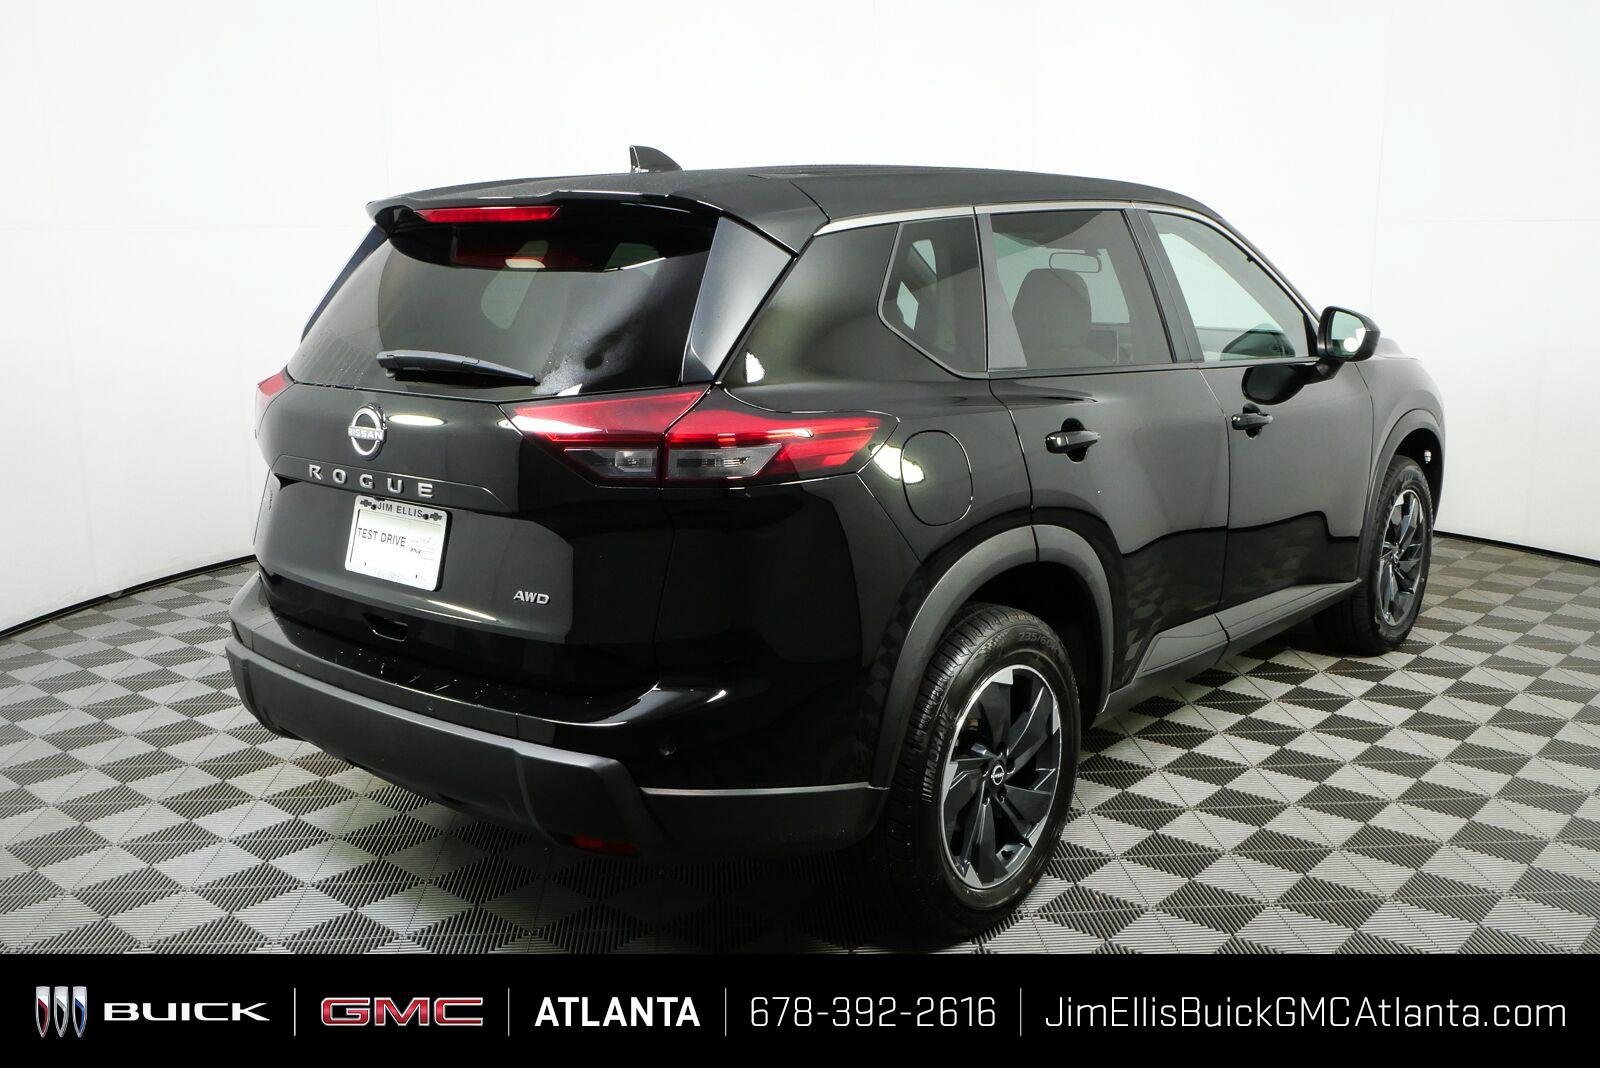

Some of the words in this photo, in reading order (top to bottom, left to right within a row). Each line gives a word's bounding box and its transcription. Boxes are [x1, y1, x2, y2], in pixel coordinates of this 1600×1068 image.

[348, 427, 386, 441] NISSAN
[308, 464, 435, 499] ROGUE
[377, 502, 393, 512] JIM
[396, 505, 423, 518] ELLIS
[357, 527, 379, 541] TEST
[380, 532, 407, 548] DRIVE
[513, 590, 551, 606] AWD
